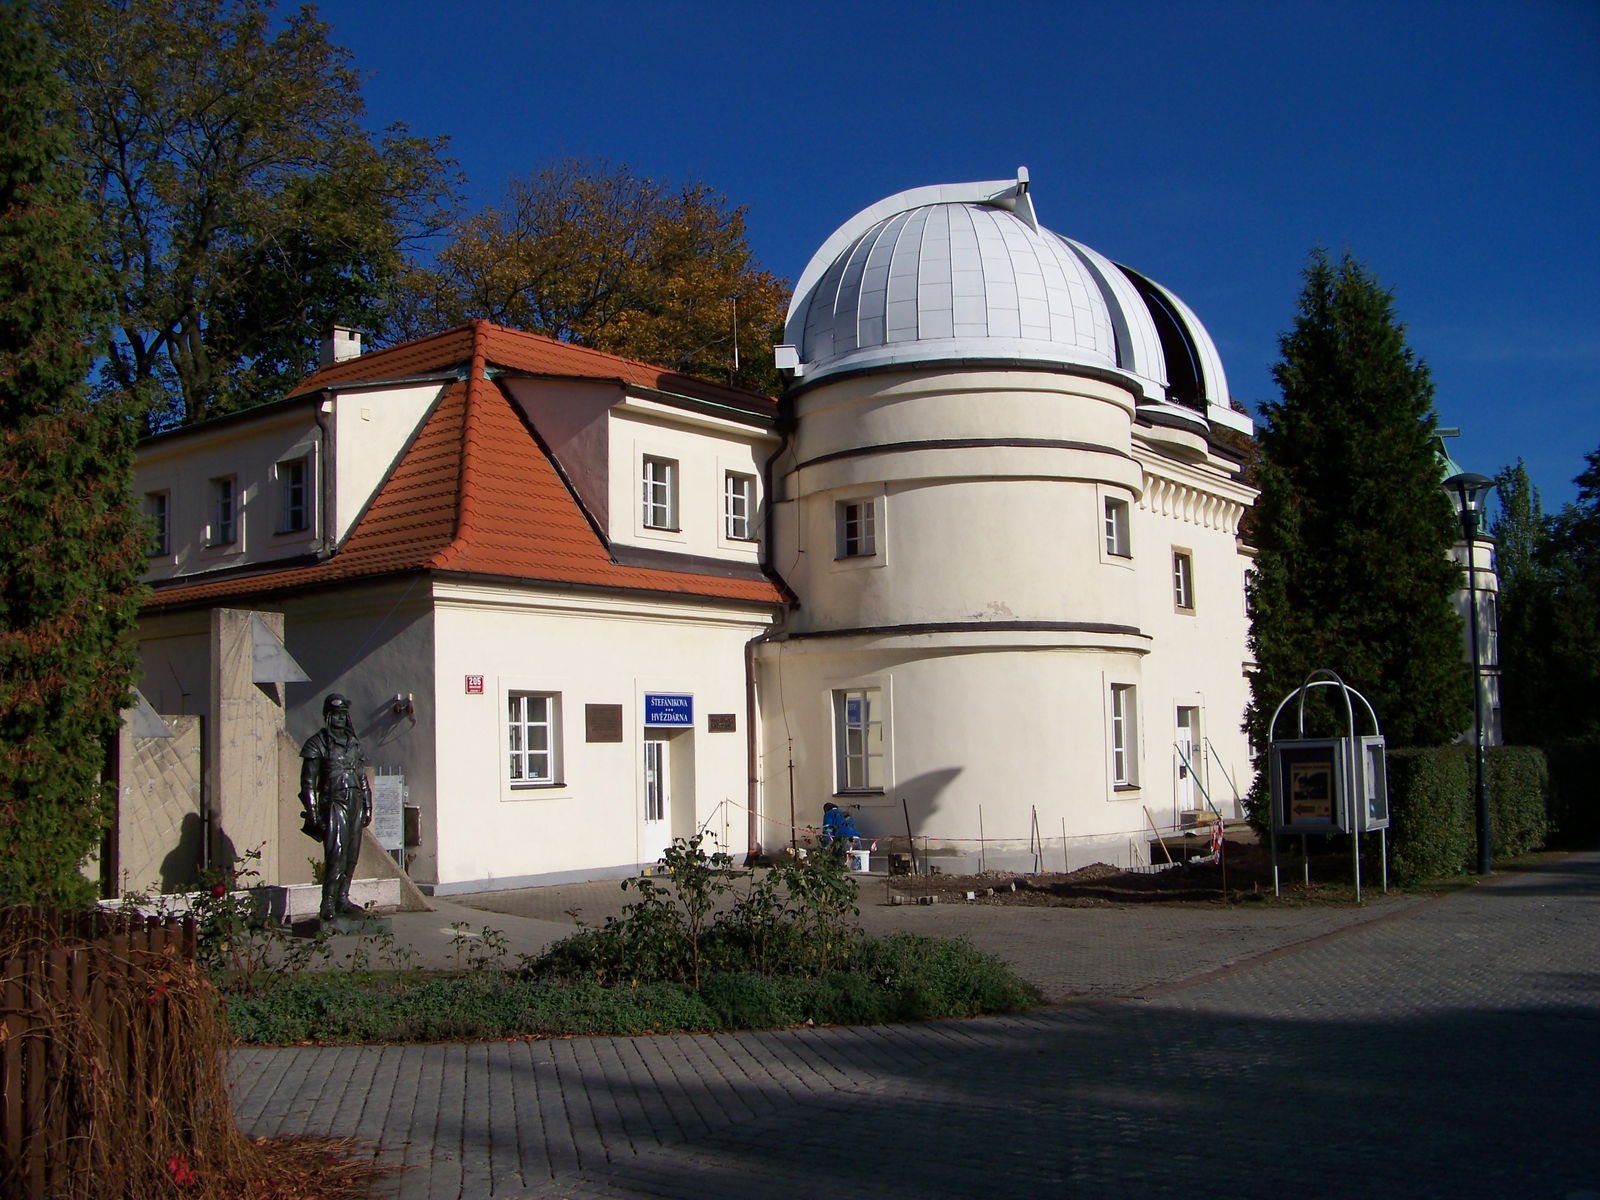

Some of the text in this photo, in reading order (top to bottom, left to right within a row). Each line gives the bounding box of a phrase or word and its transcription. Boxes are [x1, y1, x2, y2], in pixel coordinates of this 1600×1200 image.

[468, 676, 482, 686] 205
[651, 696, 688, 707] ŠTEFÁNIKOVA
[651, 711, 688, 722] HVĚZDÁRNA
